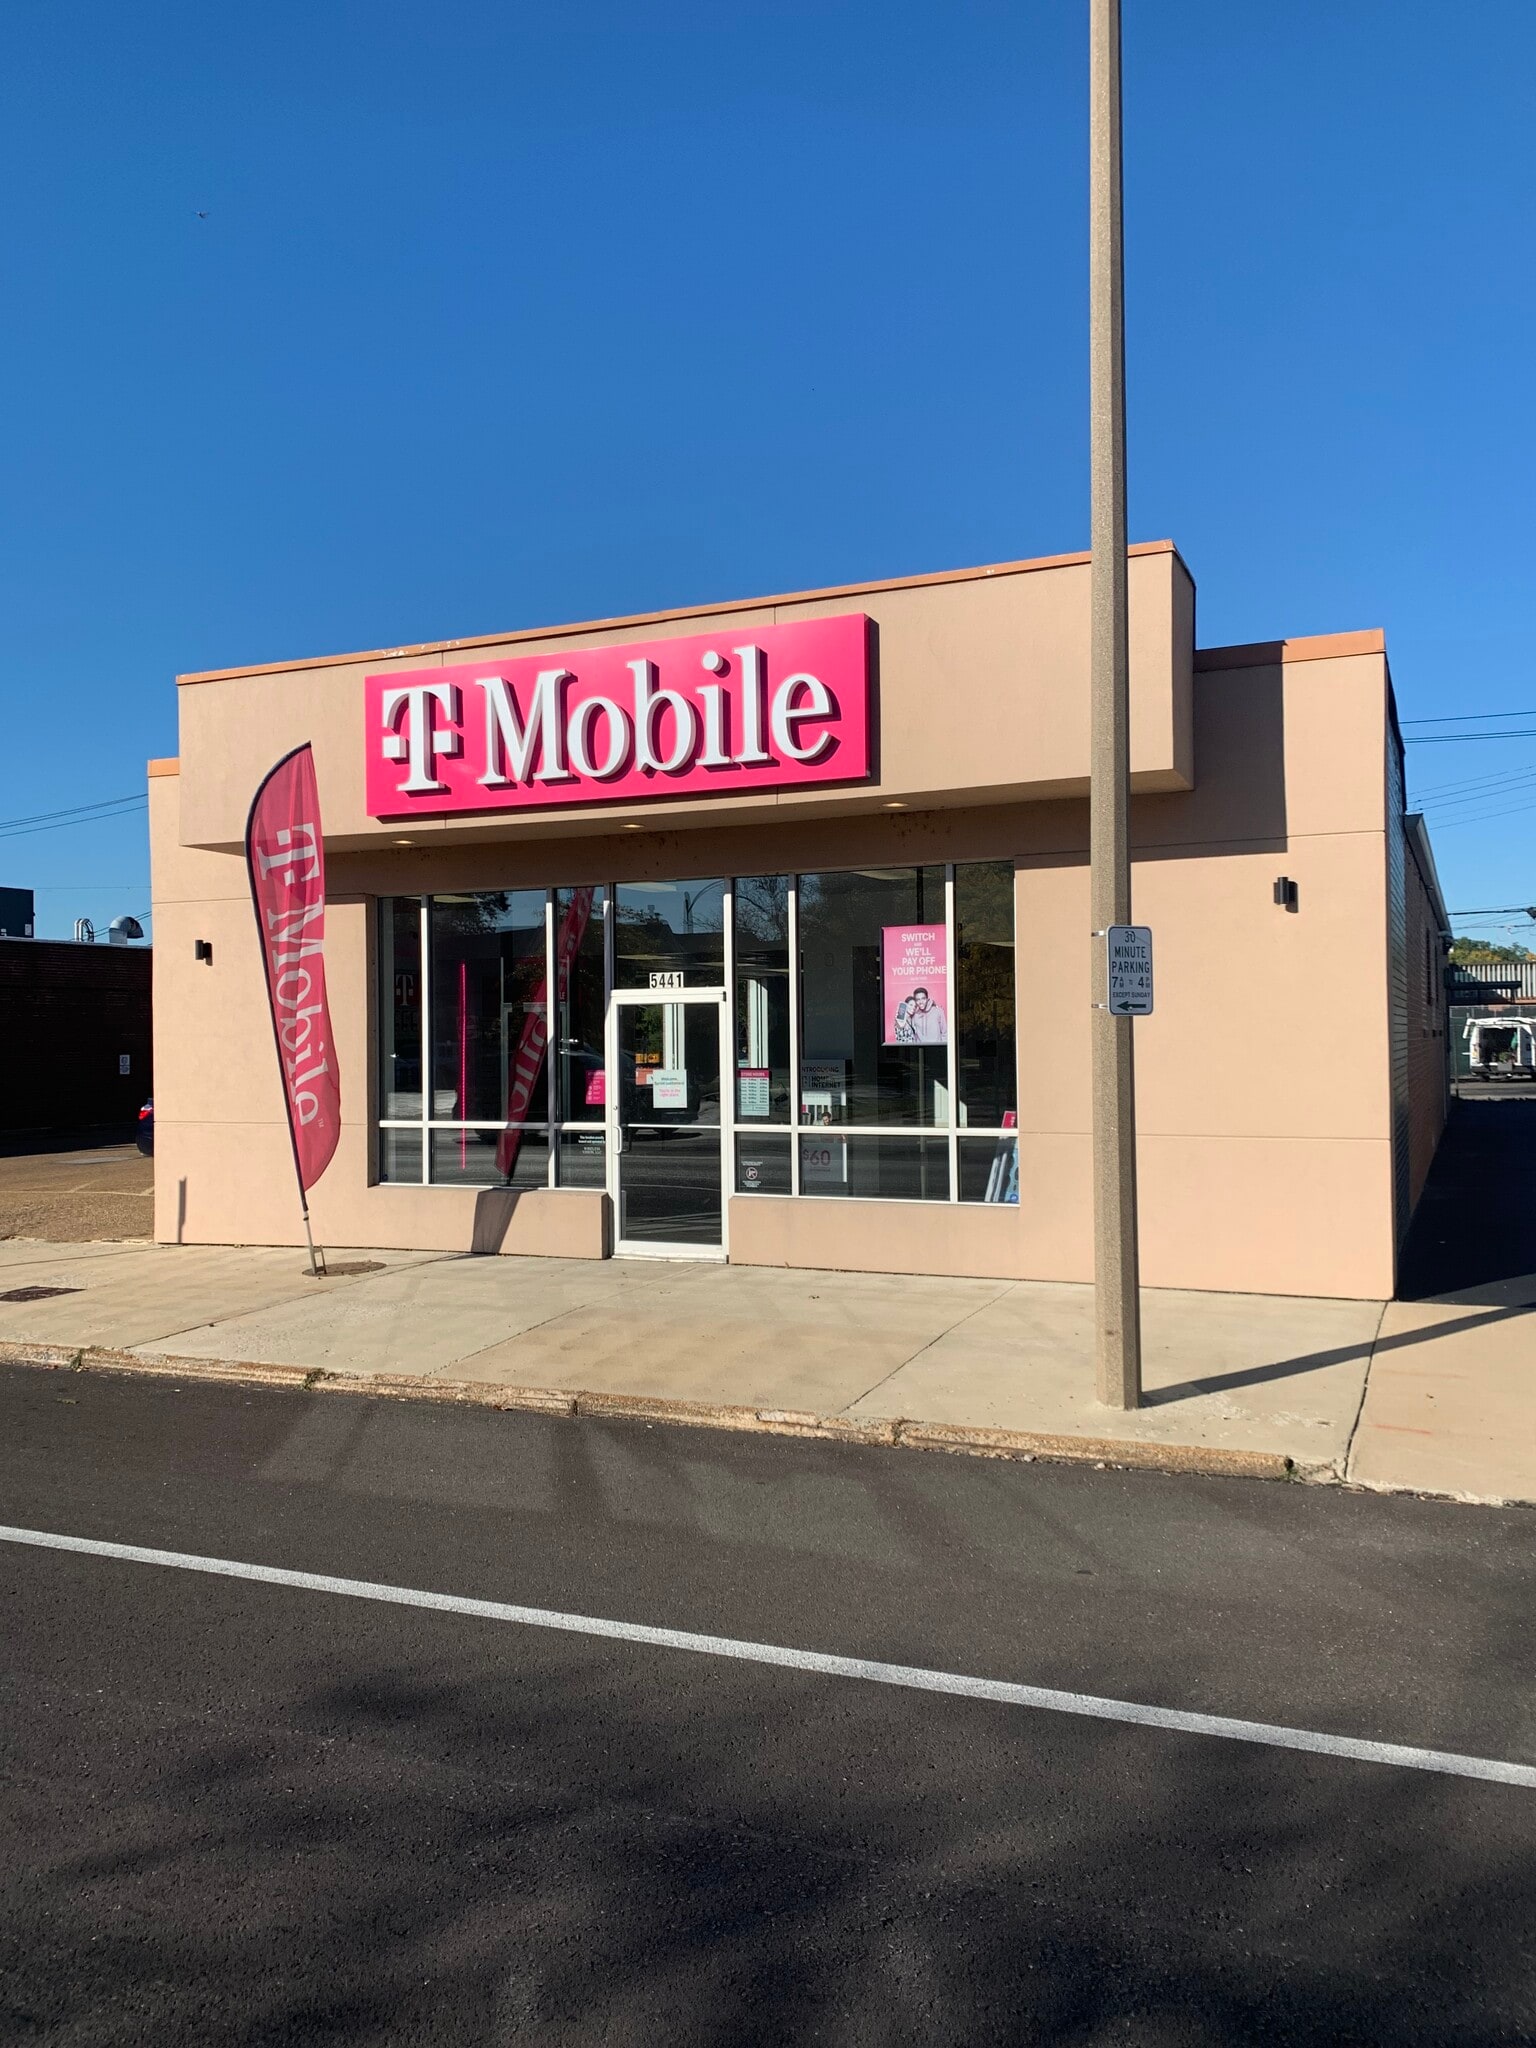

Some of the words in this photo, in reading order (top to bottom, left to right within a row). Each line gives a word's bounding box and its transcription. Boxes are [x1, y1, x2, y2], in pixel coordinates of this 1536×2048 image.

[901, 932, 935, 942] SWITCH
[1124, 931, 1136, 943] 30
[905, 947, 932, 956] WE'LL
[1114, 946, 1147, 959] MINUTE
[902, 957, 918, 966] PAY
[918, 956, 936, 965] OFF
[892, 967, 915, 976] YOUR
[916, 965, 947, 975] PHONE
[1111, 961, 1150, 974] PARKING
[651, 973, 682, 988] 5441
